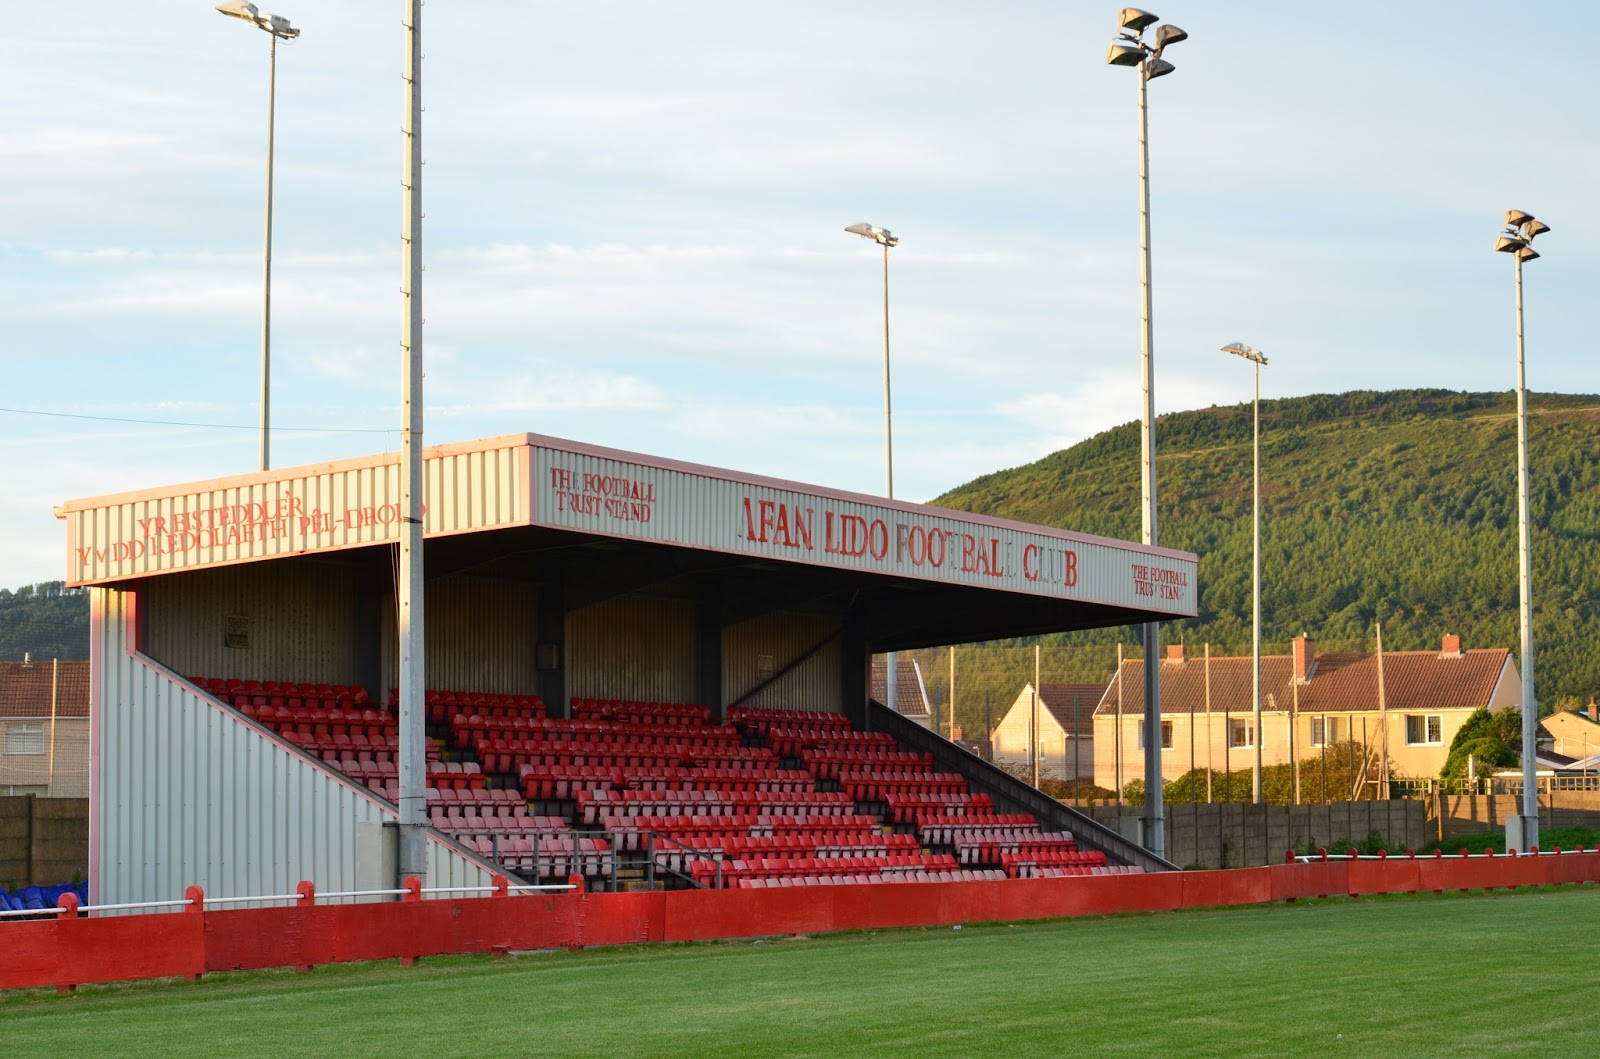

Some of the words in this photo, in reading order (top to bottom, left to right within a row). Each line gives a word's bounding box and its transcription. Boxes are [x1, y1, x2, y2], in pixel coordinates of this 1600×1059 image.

[583, 473, 656, 502] FOOTBALL
[556, 491, 602, 516] TRUST
[605, 499, 651, 522] STAND
[137, 516, 168, 537] YR
[824, 511, 889, 561] LIDO
[1131, 564, 1148, 579] THE
[1151, 567, 1187, 586] FOOTBALL
[1135, 580, 1158, 596] TRUS
[1160, 584, 1183, 600] STAN
